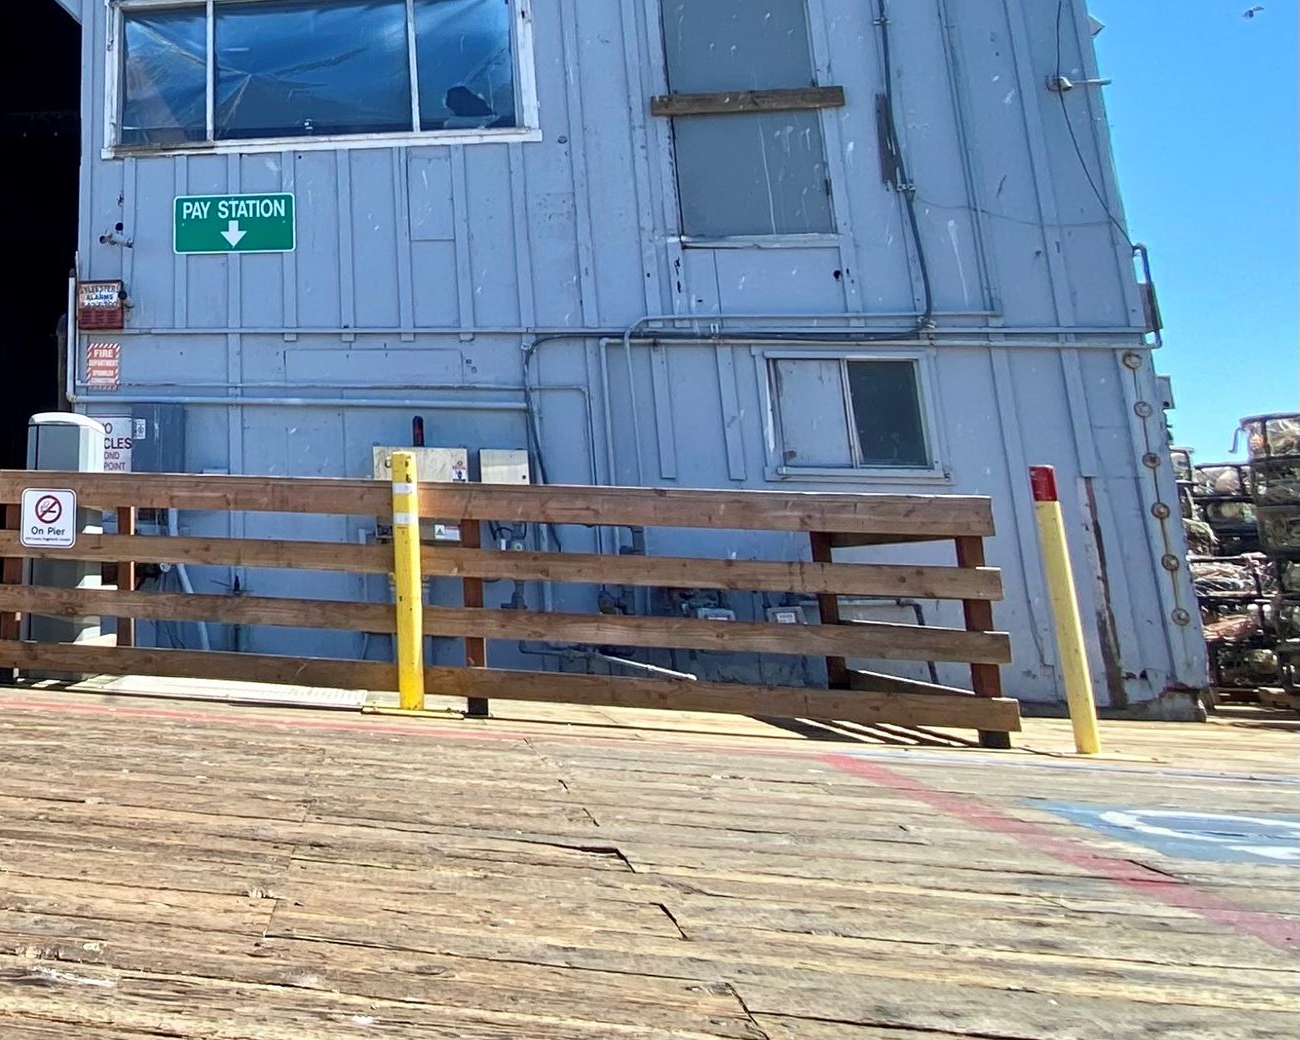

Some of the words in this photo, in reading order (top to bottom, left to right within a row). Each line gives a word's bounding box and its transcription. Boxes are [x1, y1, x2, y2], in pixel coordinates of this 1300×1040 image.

[183, 201, 211, 219] PAY
[218, 199, 285, 219] STATION
[94, 349, 113, 358] FIRE
[104, 437, 132, 449] CLES
[104, 451, 120, 460] OND
[104, 462, 125, 471] POINT
[31, 526, 44, 535] On
[47, 527, 66, 536] Pier
